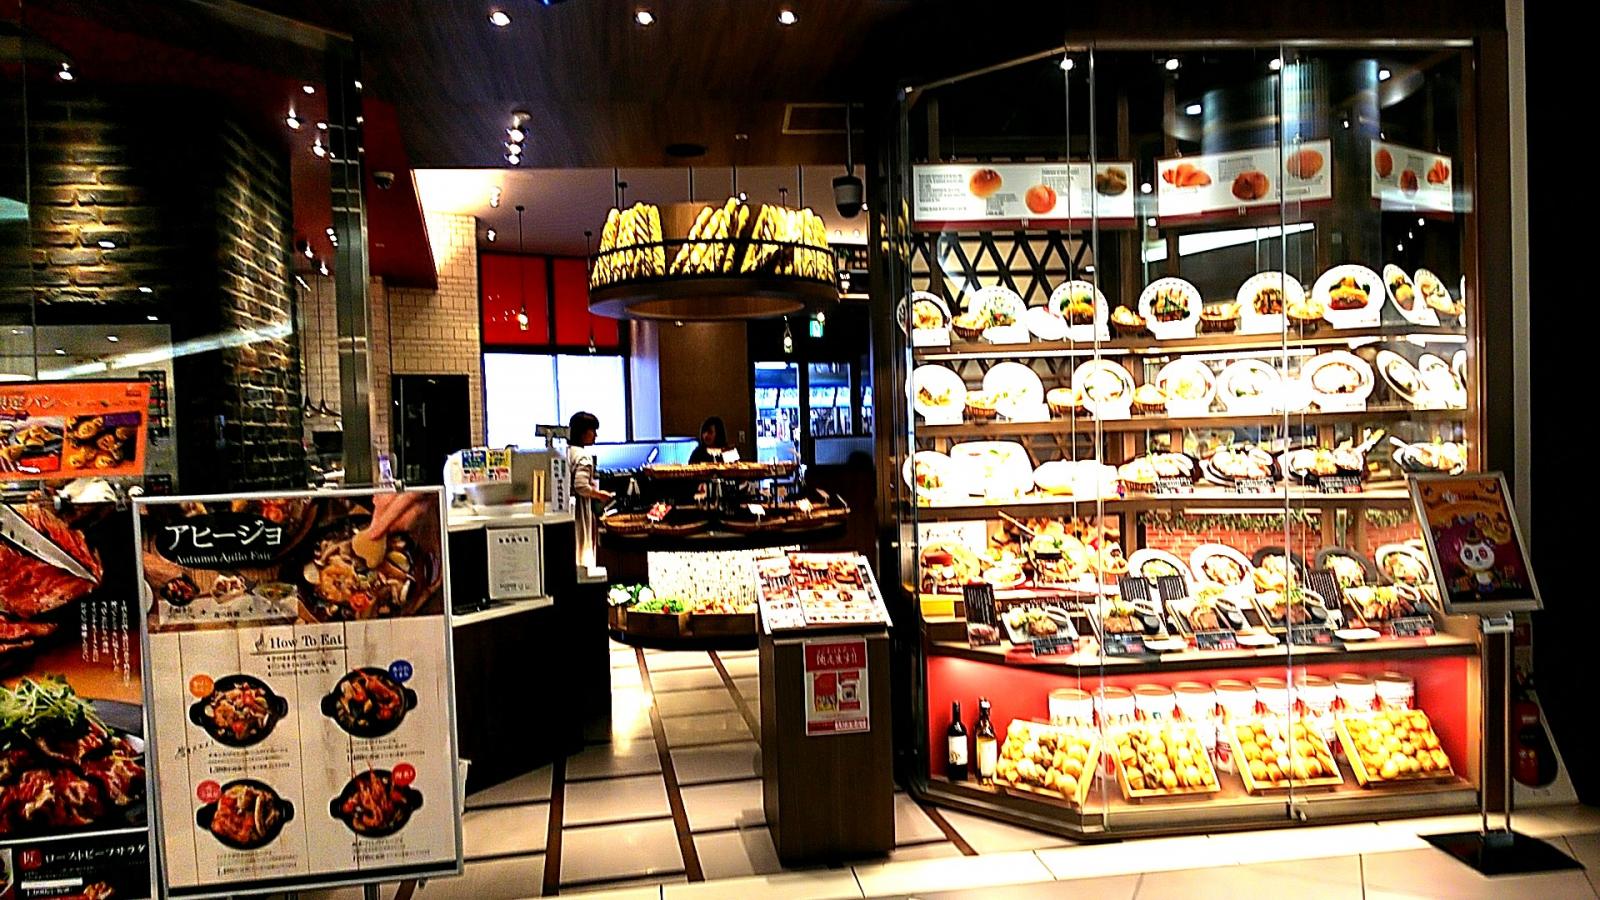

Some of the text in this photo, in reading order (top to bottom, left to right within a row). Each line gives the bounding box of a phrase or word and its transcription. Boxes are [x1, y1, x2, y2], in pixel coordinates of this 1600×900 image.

[165, 519, 282, 551] アヒージョ
[177, 554, 218, 565] Autumn
[251, 551, 272, 560] Fair
[270, 634, 343, 650] How To Eat
